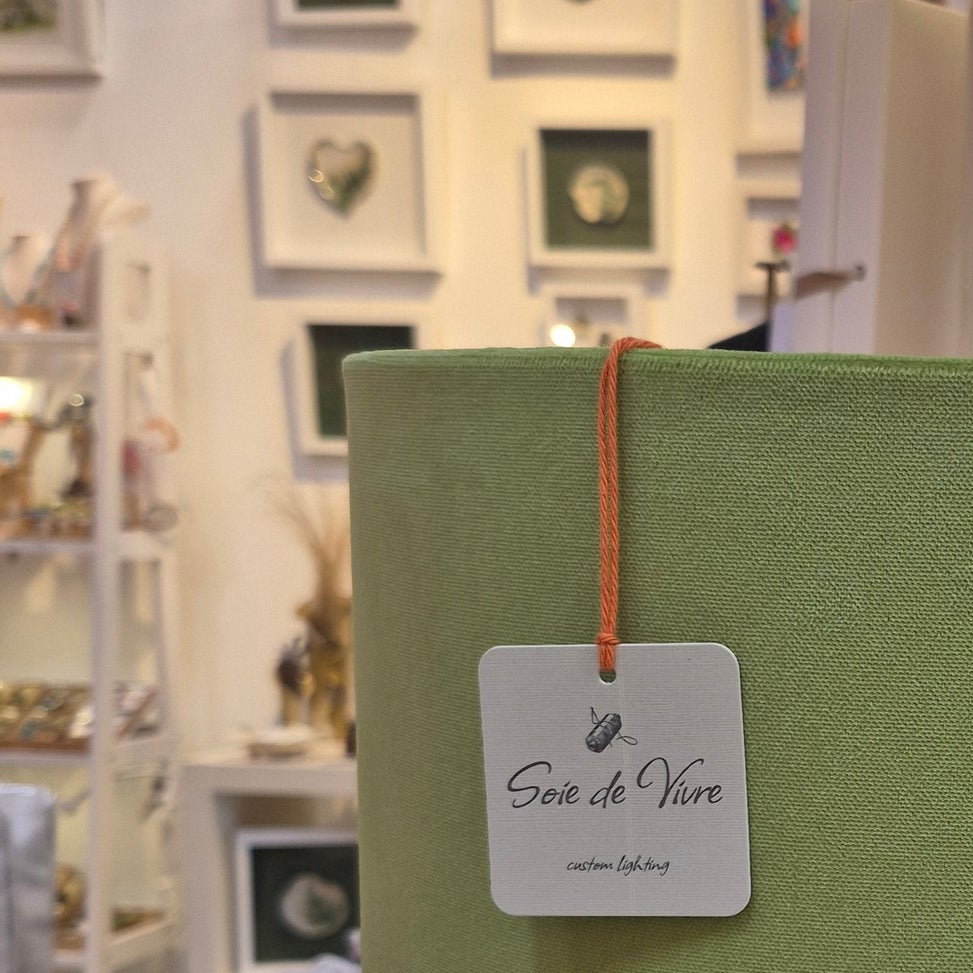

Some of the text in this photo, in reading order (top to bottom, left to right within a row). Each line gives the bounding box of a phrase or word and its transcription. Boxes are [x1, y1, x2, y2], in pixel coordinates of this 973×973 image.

[507, 756, 724, 809] Soie de Vivre
[566, 854, 670, 877] custom lighting
